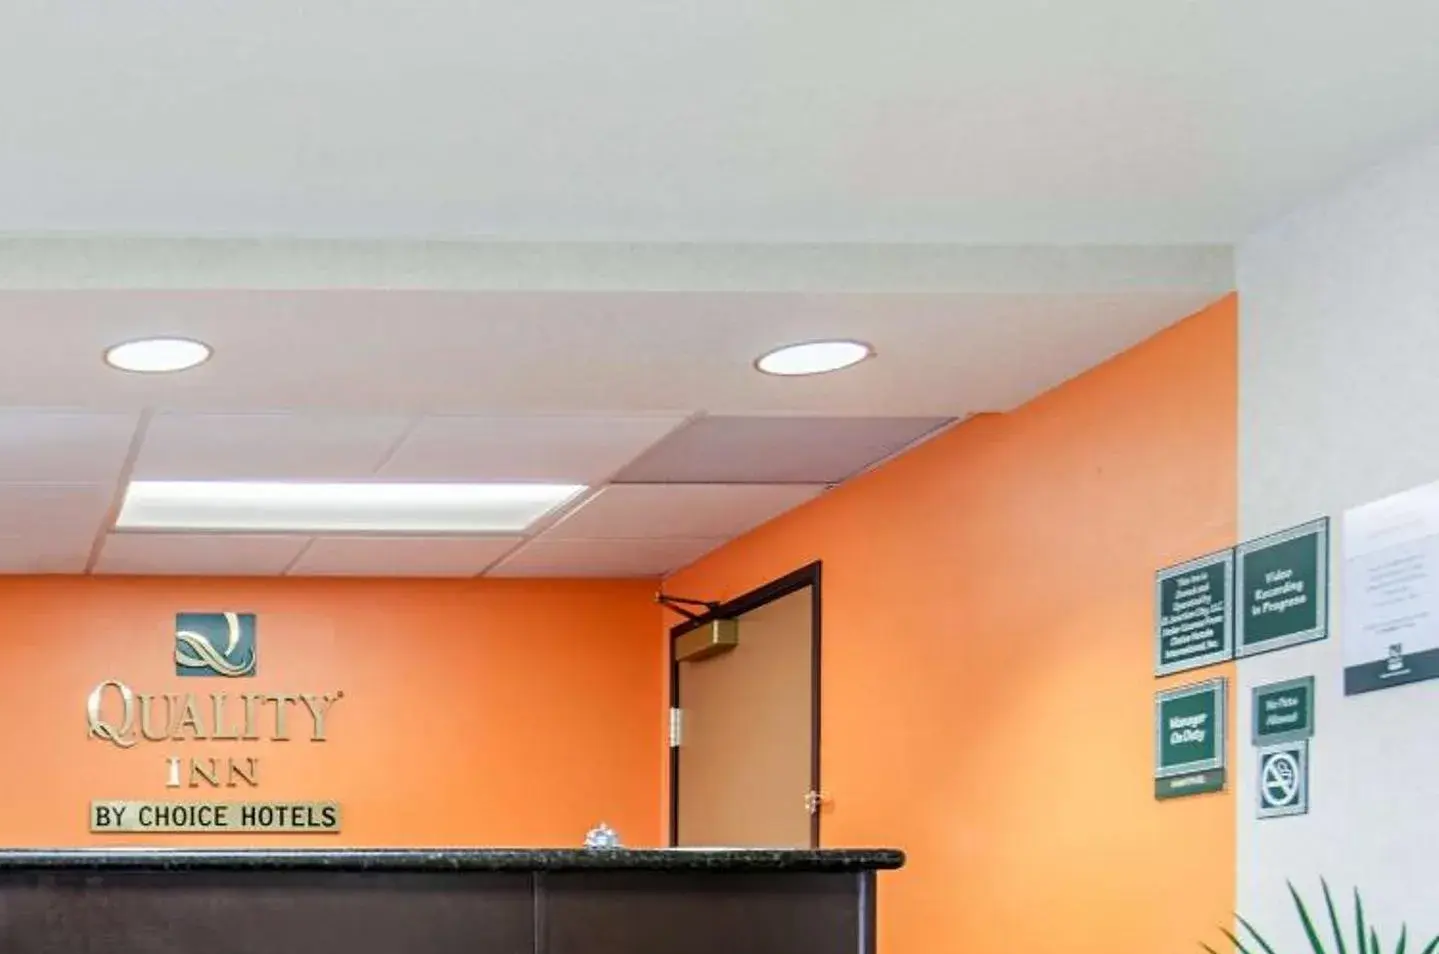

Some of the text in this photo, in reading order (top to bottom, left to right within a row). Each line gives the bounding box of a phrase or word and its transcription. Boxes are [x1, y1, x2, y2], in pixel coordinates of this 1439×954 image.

[87, 680, 338, 748] QUALITY
[165, 757, 260, 788] INN
[96, 806, 337, 827] BY CHOICE HOTELS
